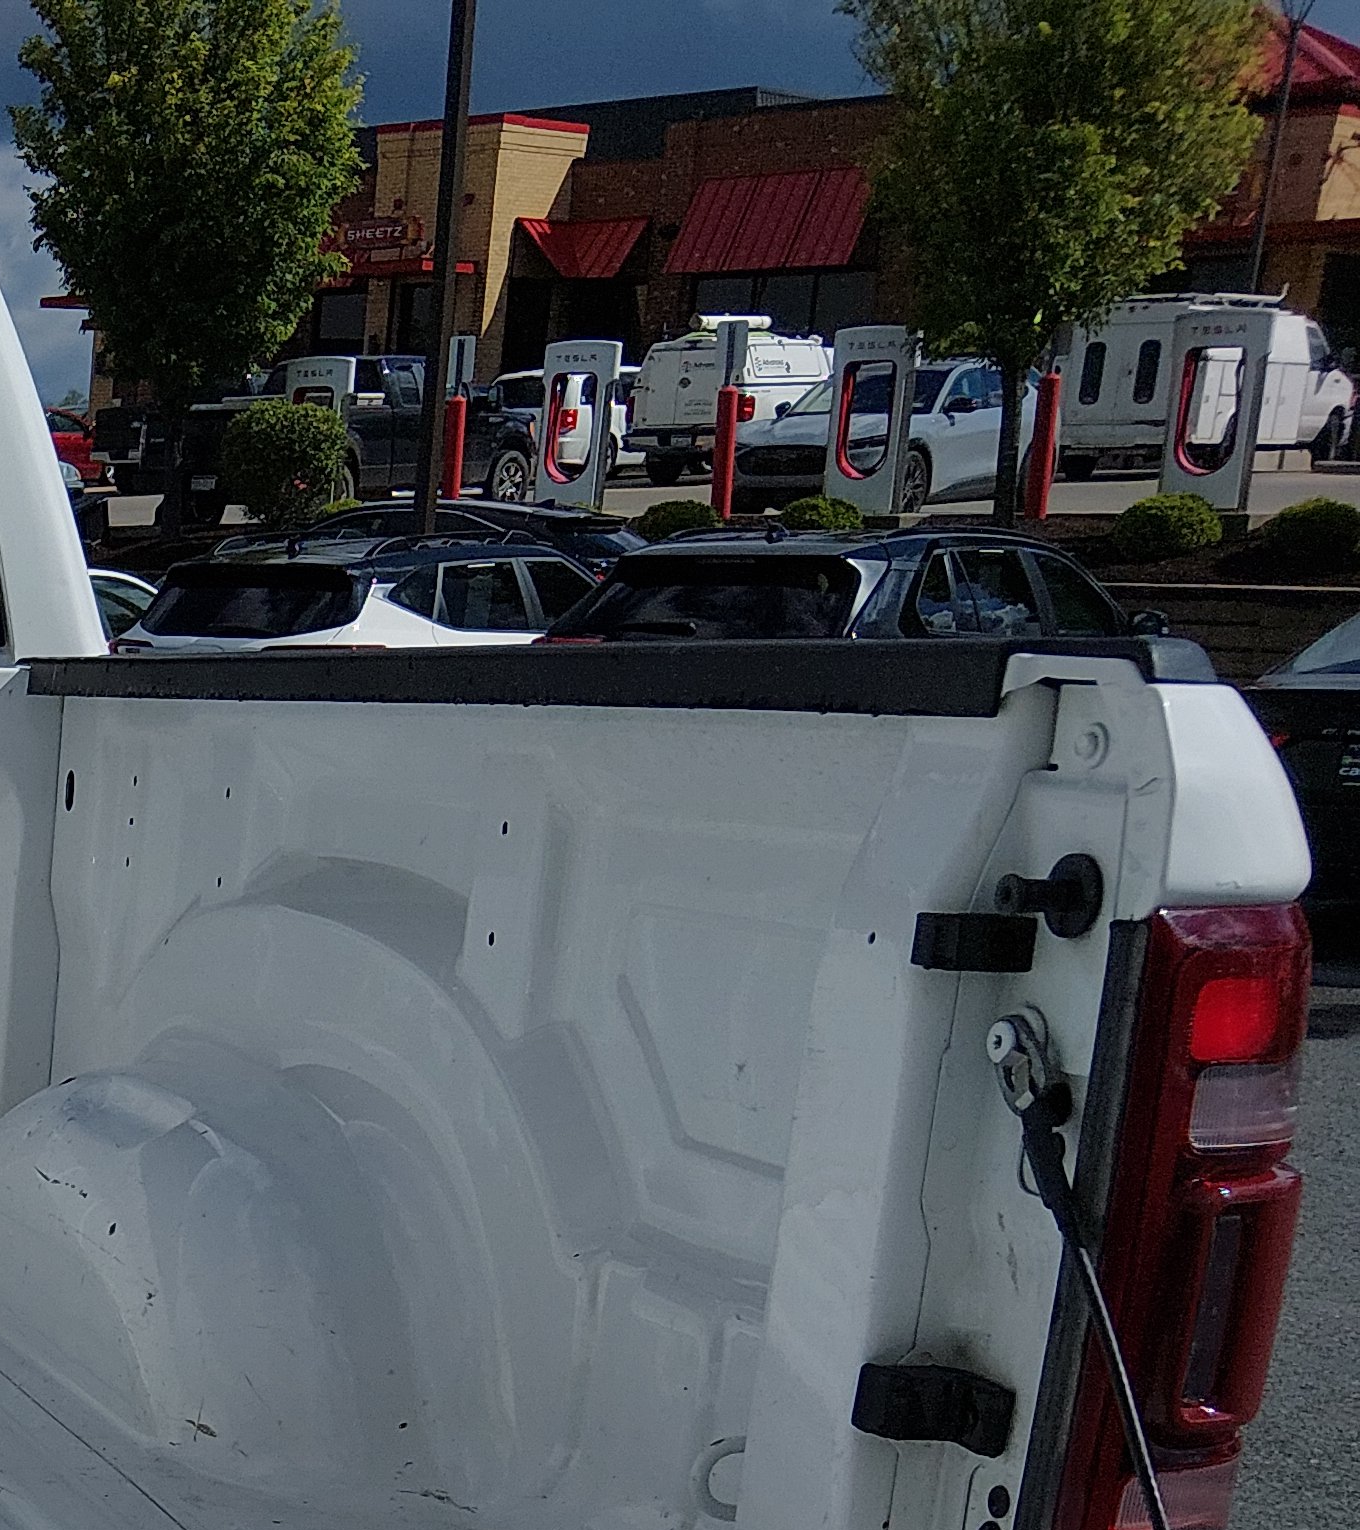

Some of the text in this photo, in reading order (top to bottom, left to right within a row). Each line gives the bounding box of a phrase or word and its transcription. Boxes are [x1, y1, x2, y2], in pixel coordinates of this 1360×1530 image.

[347, 226, 403, 240] SHEETZ
[1191, 323, 1247, 336] TESLA
[848, 340, 897, 350] TESLA
[556, 353, 597, 362] TESLA
[296, 369, 334, 378] TESLA
